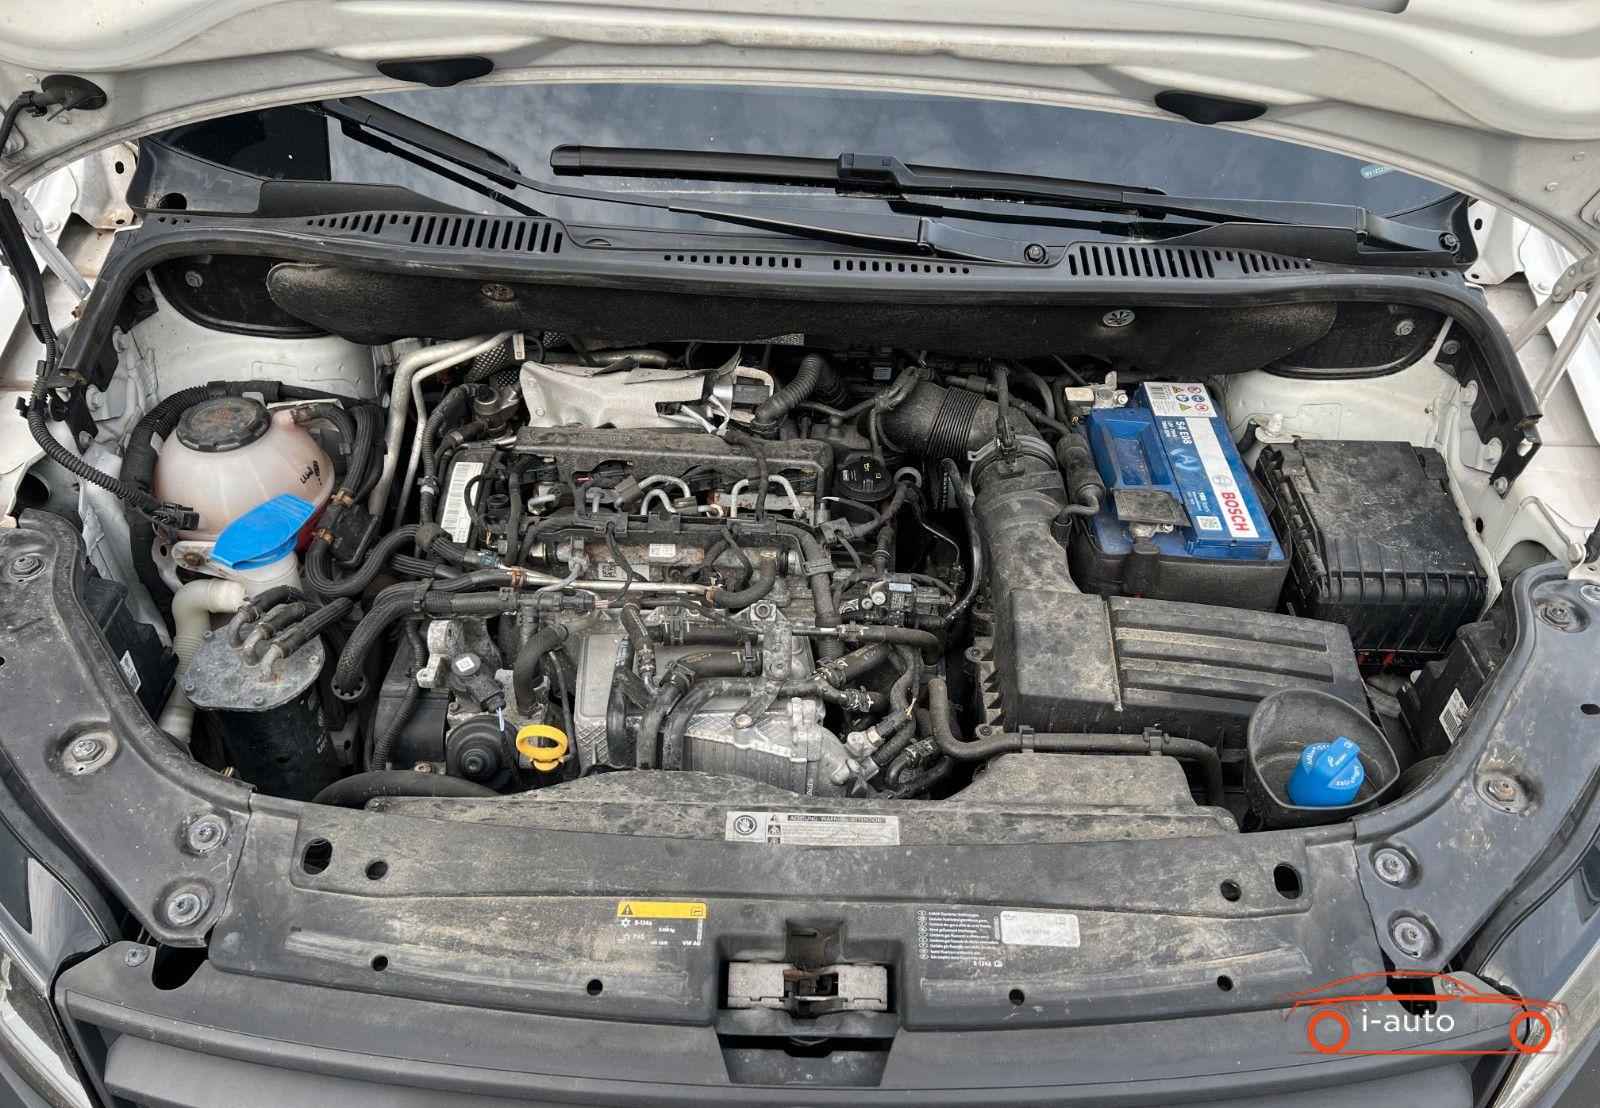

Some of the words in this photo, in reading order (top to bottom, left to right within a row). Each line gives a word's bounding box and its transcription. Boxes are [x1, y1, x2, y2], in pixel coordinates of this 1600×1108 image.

[1176, 421, 1187, 430] S4
[1180, 431, 1193, 445] E08
[1220, 491, 1250, 532] BOSCH
